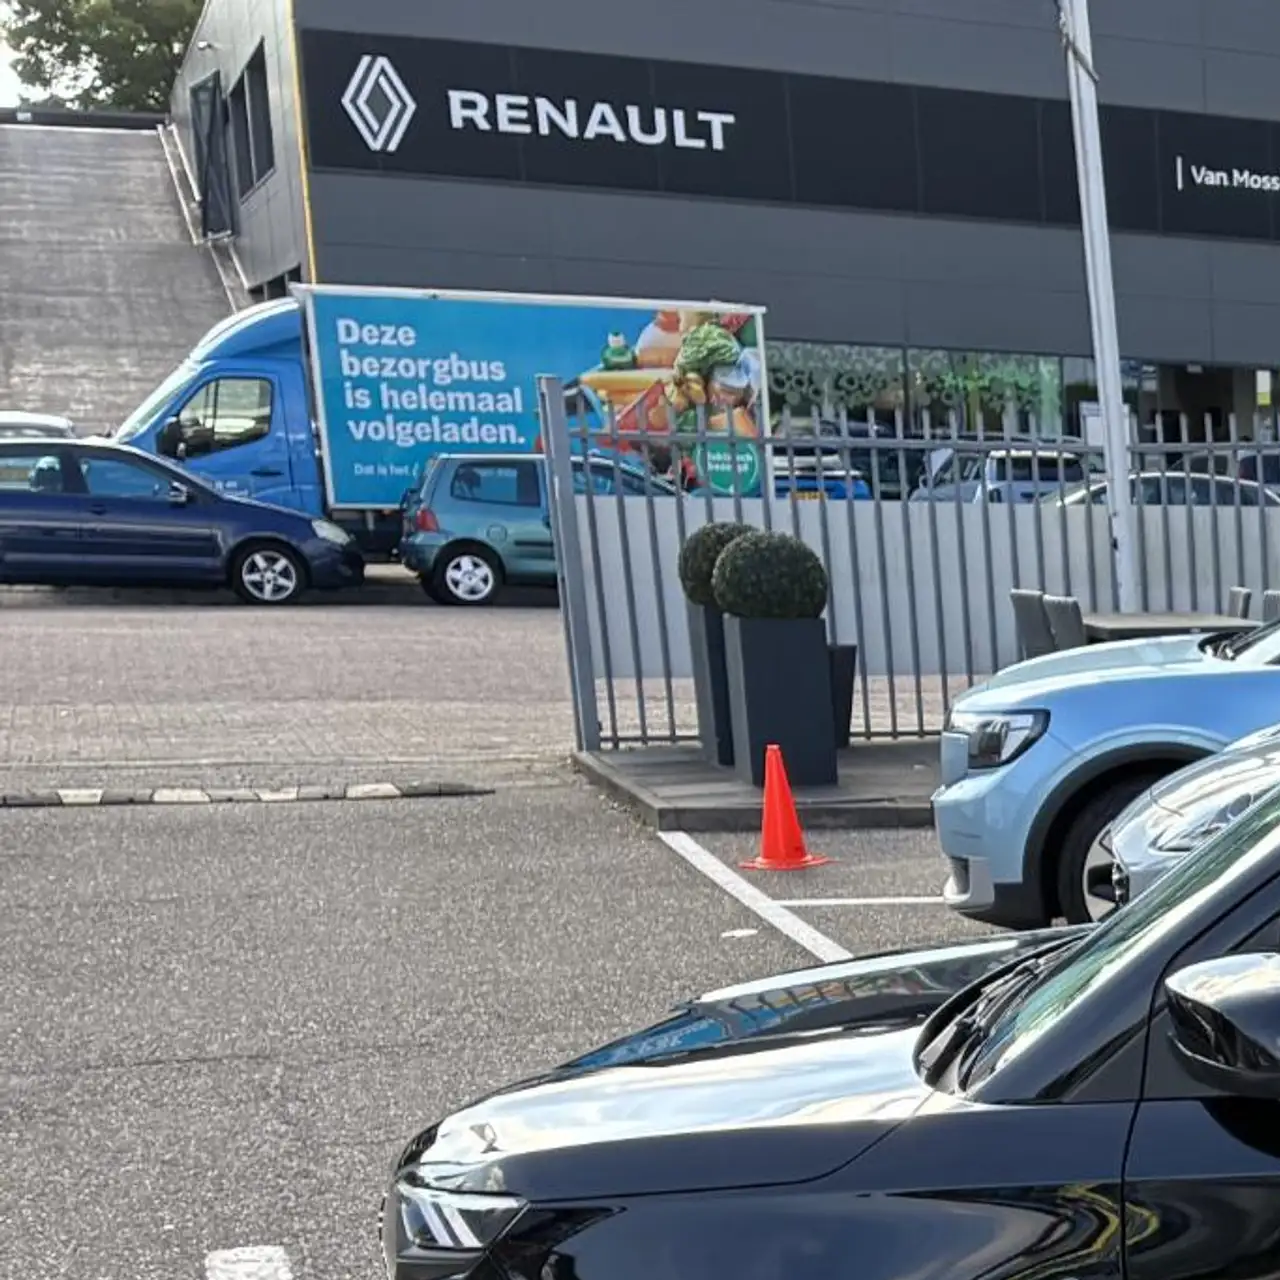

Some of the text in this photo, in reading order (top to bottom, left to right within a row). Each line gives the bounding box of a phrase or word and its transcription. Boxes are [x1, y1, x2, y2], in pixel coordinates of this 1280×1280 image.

[447, 89, 735, 150] RENAULT
[1190, 164, 1229, 187] Van
[336, 318, 416, 346] Deze
[340, 348, 507, 385] bezorgbus
[344, 381, 523, 413] is helemaal
[347, 413, 526, 447] volgeladen.
